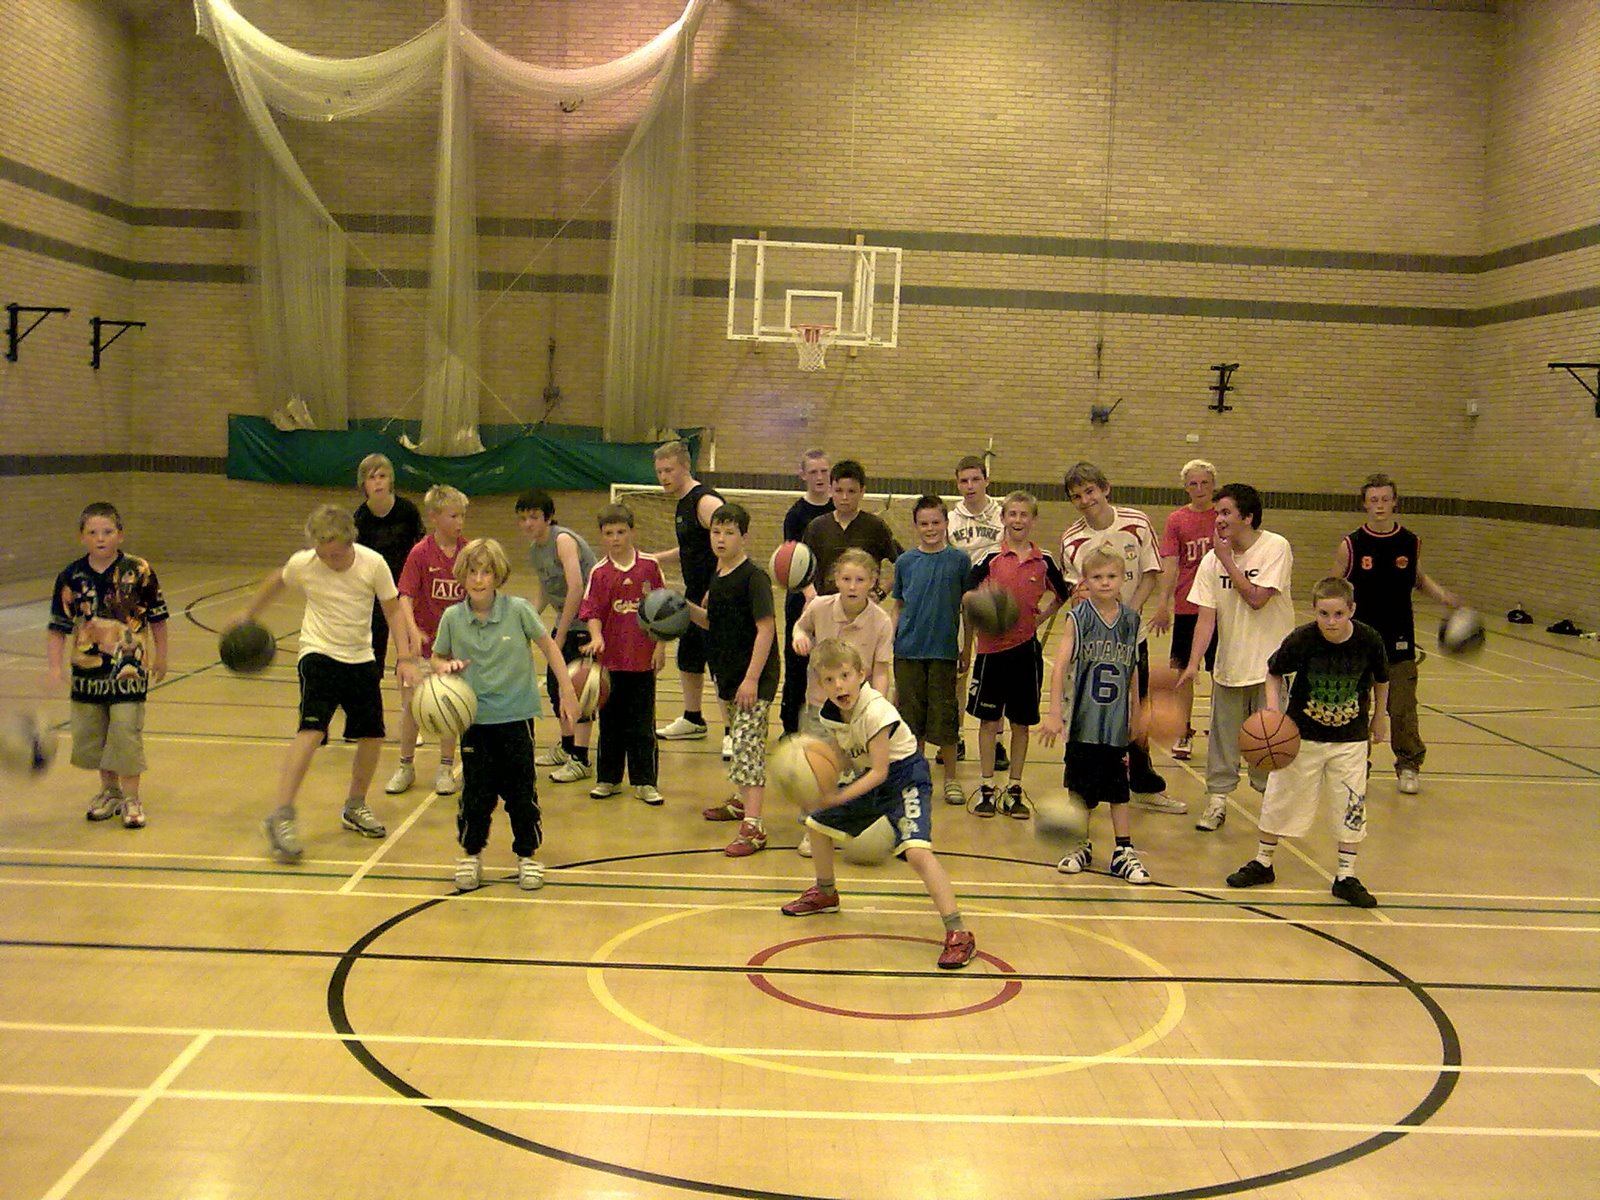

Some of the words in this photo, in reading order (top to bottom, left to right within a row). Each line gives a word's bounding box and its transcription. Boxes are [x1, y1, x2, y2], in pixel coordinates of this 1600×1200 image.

[975, 526, 1001, 541] YORK
[1361, 556, 1373, 569] 8
[435, 582, 465, 597] AIG
[1083, 641, 1134, 666] MIAMI
[1090, 662, 1121, 705] 6
